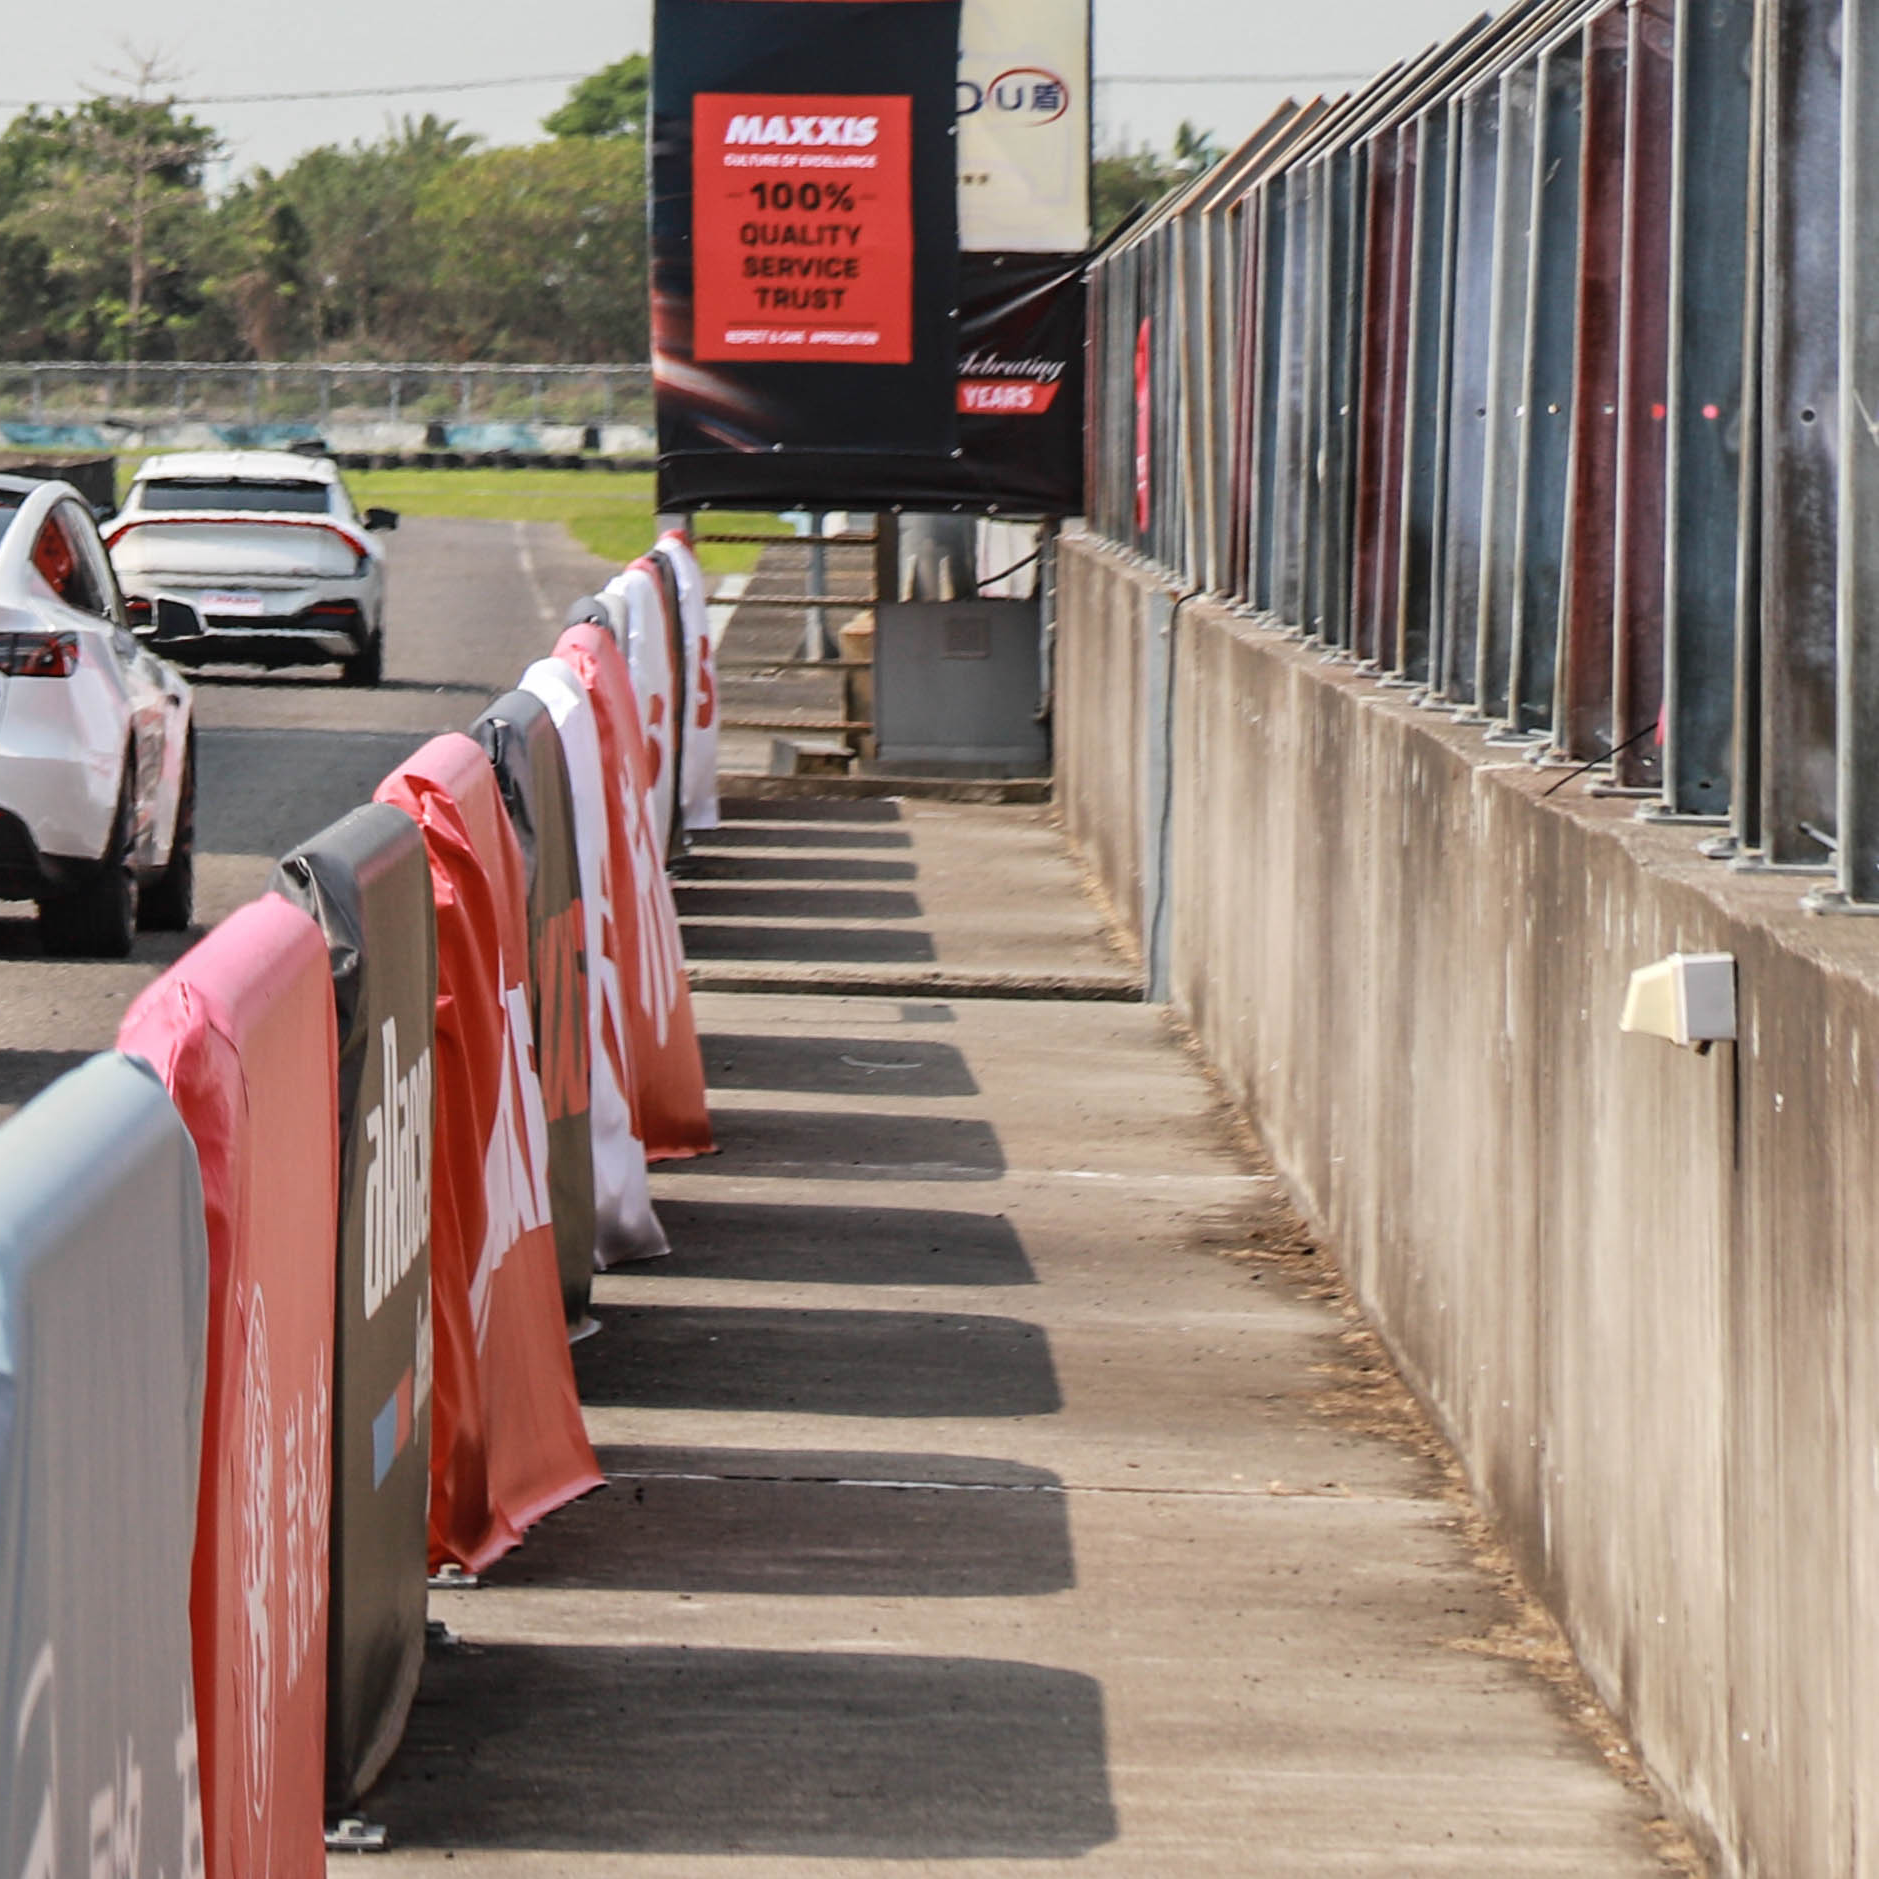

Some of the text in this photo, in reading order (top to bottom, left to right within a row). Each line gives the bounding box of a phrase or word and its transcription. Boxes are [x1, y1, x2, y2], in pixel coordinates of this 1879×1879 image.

[724, 115, 879, 148] MAXXIS
[751, 180, 856, 213] 100%
[740, 222, 862, 248] QUALITY
[743, 255, 860, 280] SERVICE
[755, 286, 848, 311] TRUST
[963, 384, 1034, 409] YEARS
